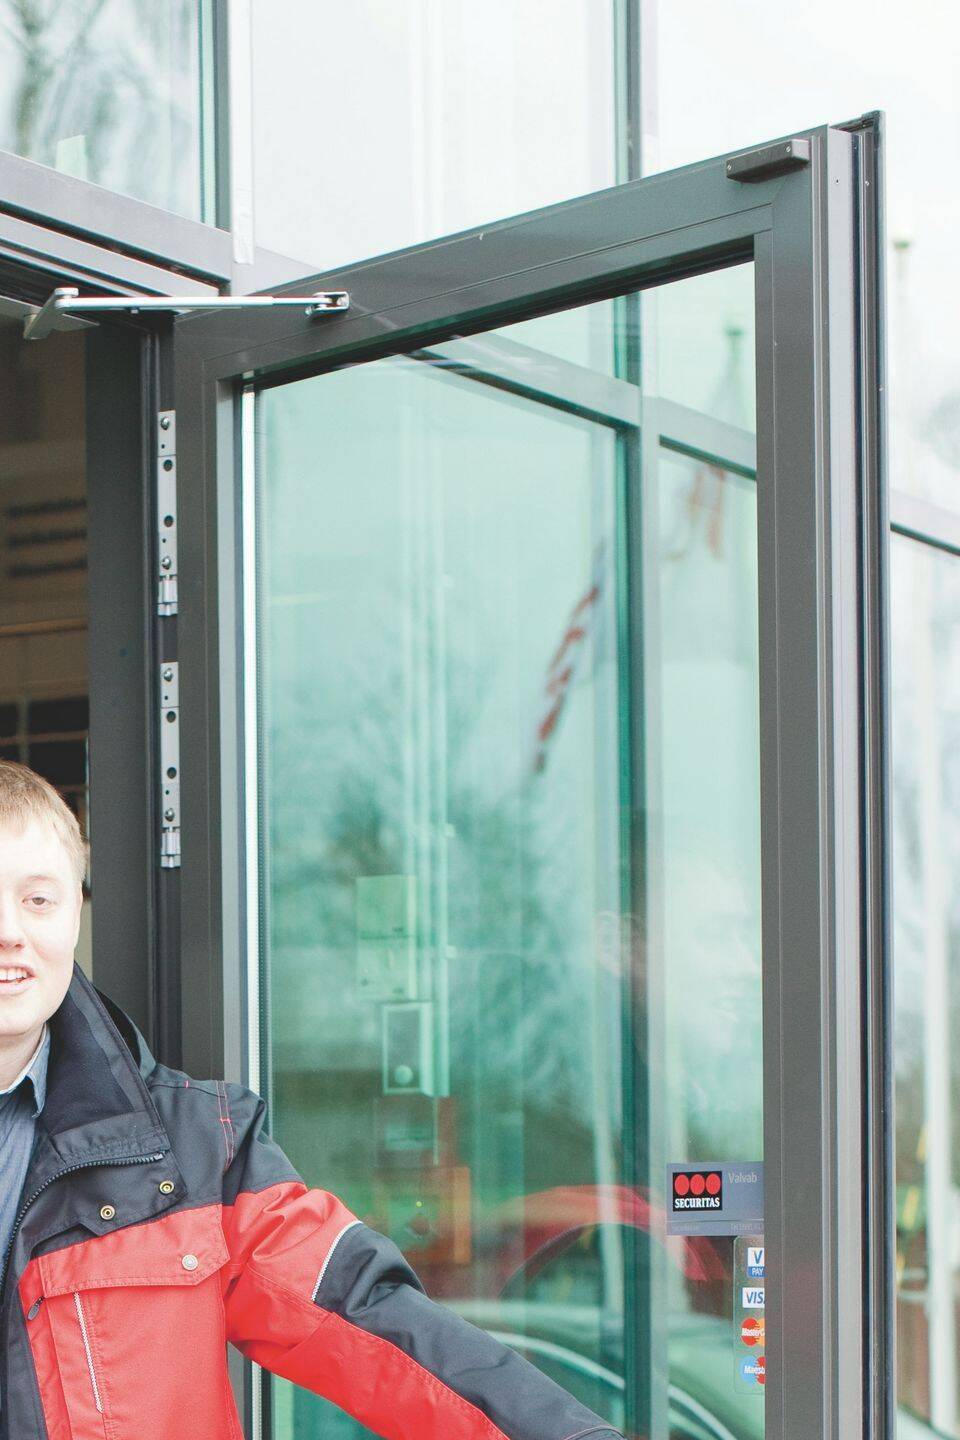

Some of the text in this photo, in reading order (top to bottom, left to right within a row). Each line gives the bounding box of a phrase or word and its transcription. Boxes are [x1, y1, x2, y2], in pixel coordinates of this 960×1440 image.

[728, 1172, 758, 1184] Valvab
[674, 1197, 721, 1209] SECURITAS
[751, 1267, 764, 1276] PAY
[746, 1291, 765, 1304] VIS
